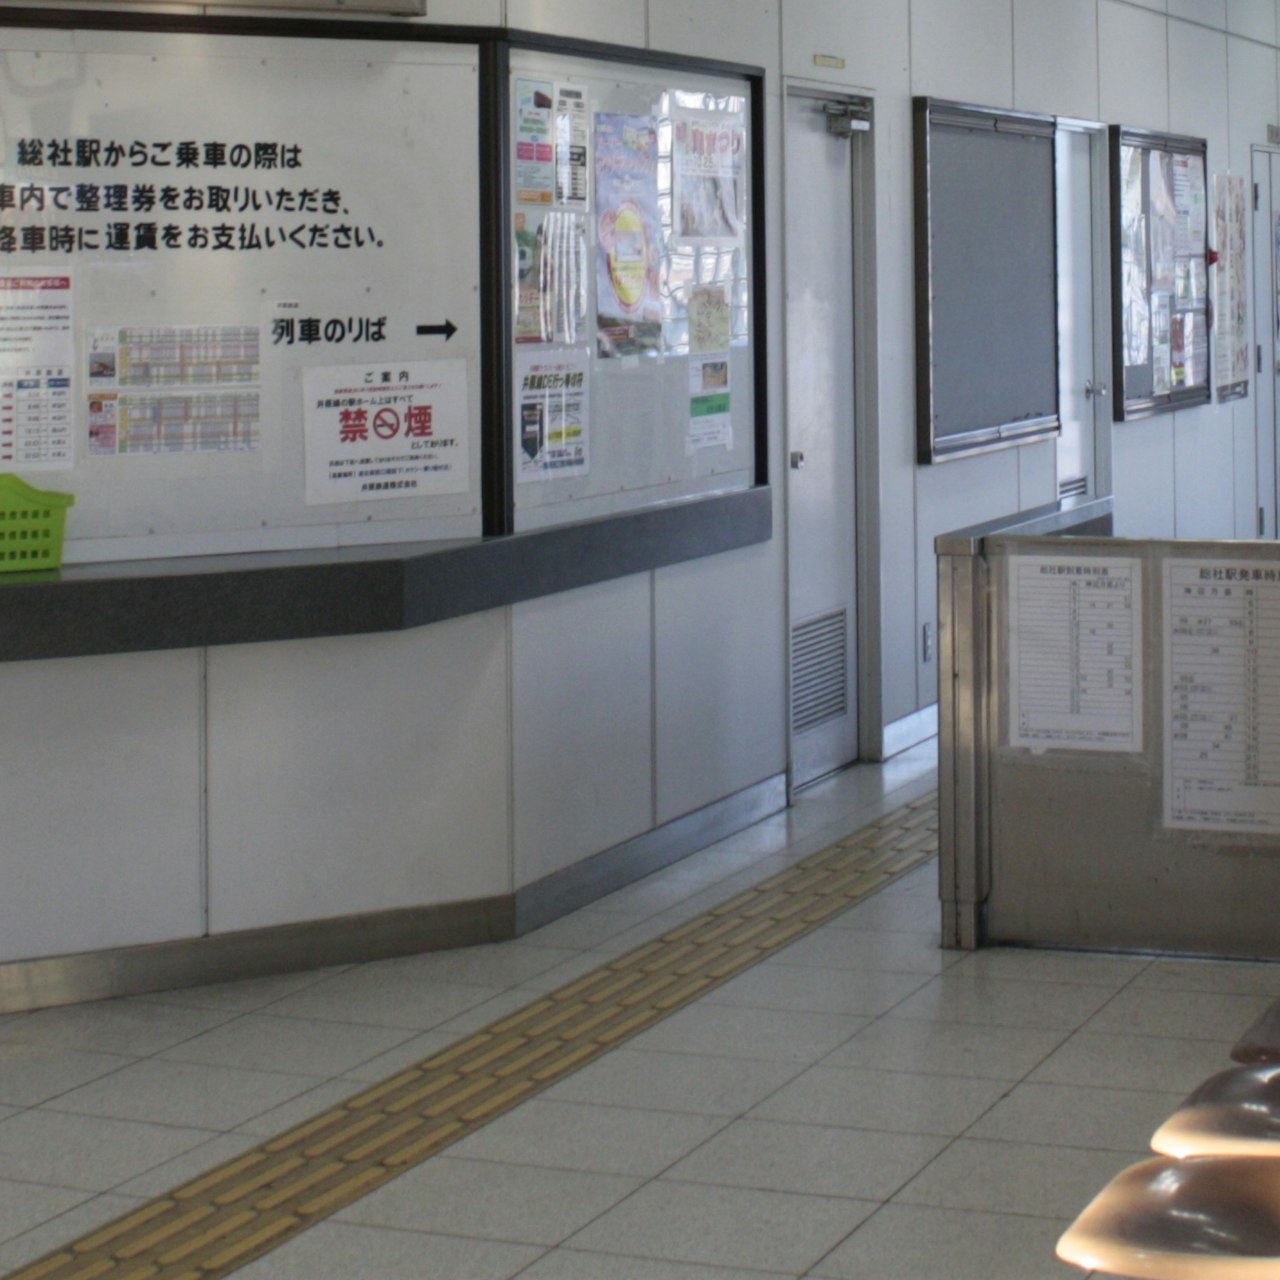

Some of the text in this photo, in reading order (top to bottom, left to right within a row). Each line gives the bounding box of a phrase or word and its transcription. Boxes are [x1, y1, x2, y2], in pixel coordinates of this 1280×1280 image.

[16, 137, 302, 169] 総社駅からご乗車の際は
[272, 316, 388, 346] 列車のりば
[364, 370, 410, 384] ご案内
